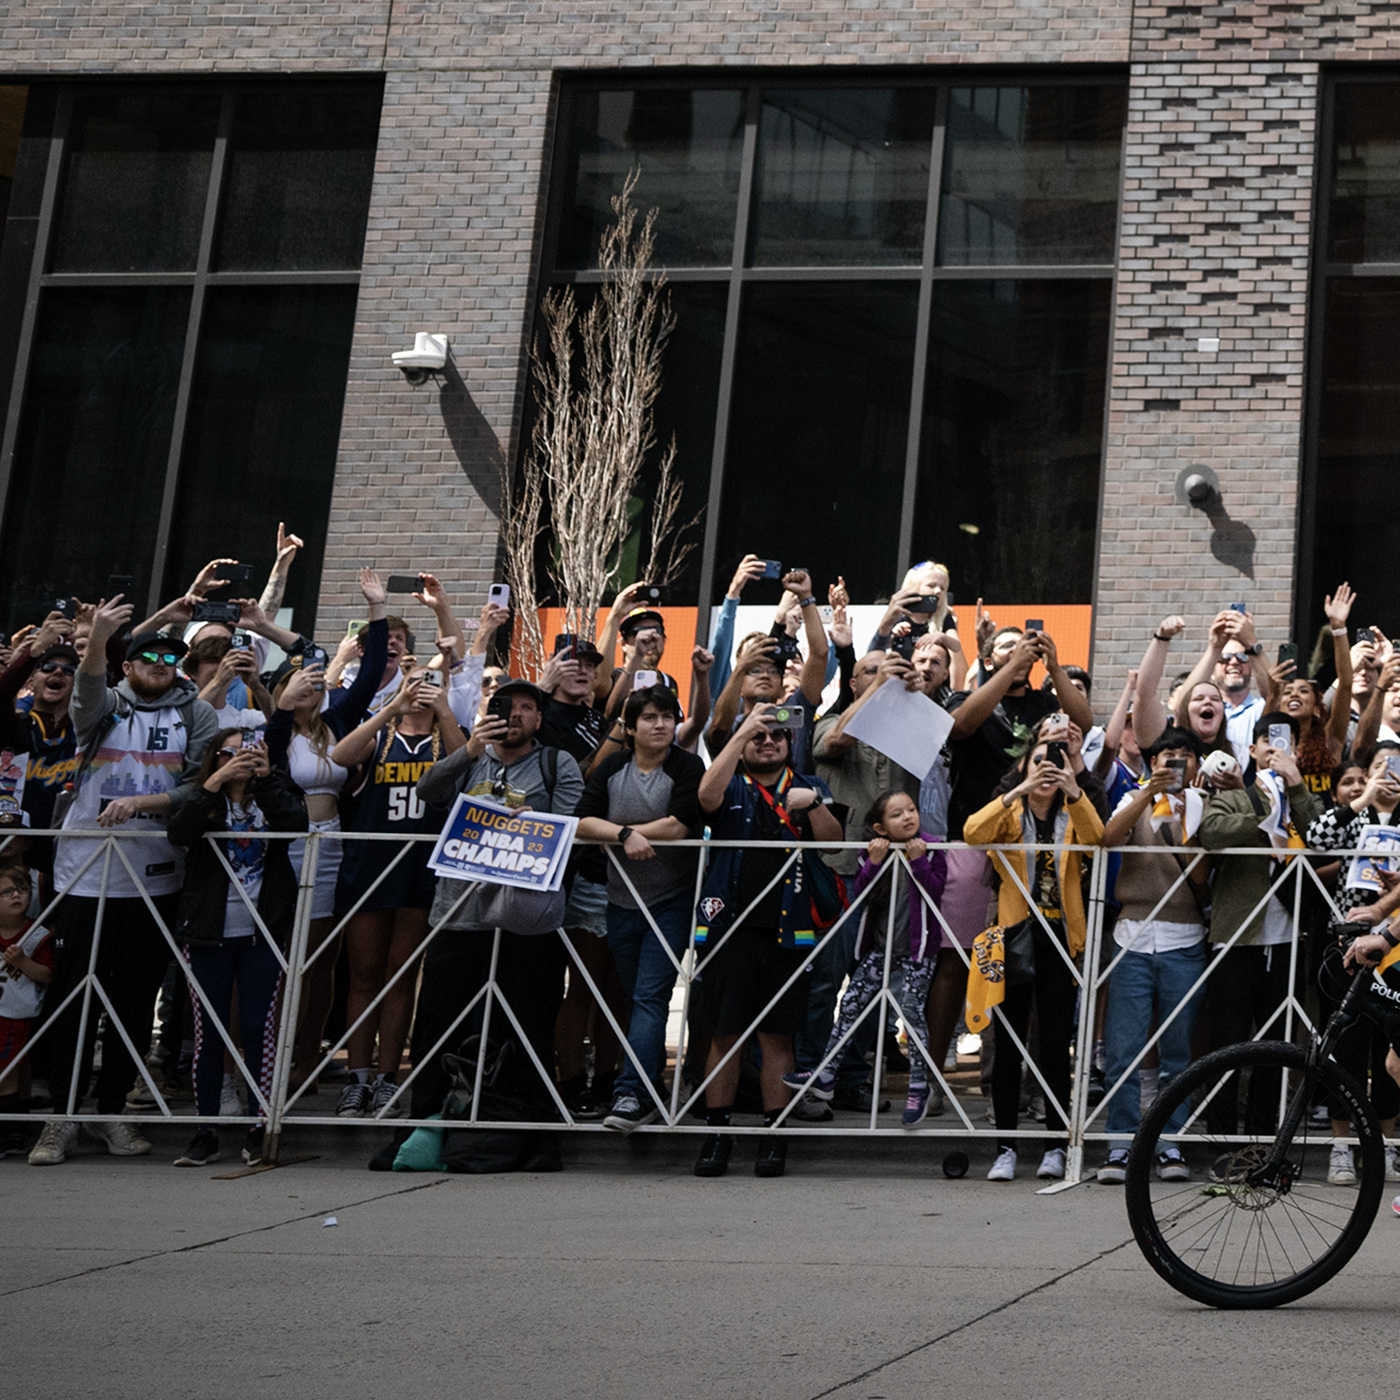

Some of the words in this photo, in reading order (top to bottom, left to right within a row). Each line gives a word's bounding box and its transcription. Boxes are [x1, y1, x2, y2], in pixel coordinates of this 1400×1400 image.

[147, 726, 169, 751] 15
[465, 806, 556, 839] NUGGETS
[462, 828, 480, 840] 20
[479, 829, 525, 853] NBA
[526, 842, 544, 853] 23
[443, 838, 551, 876] CHAMPS
